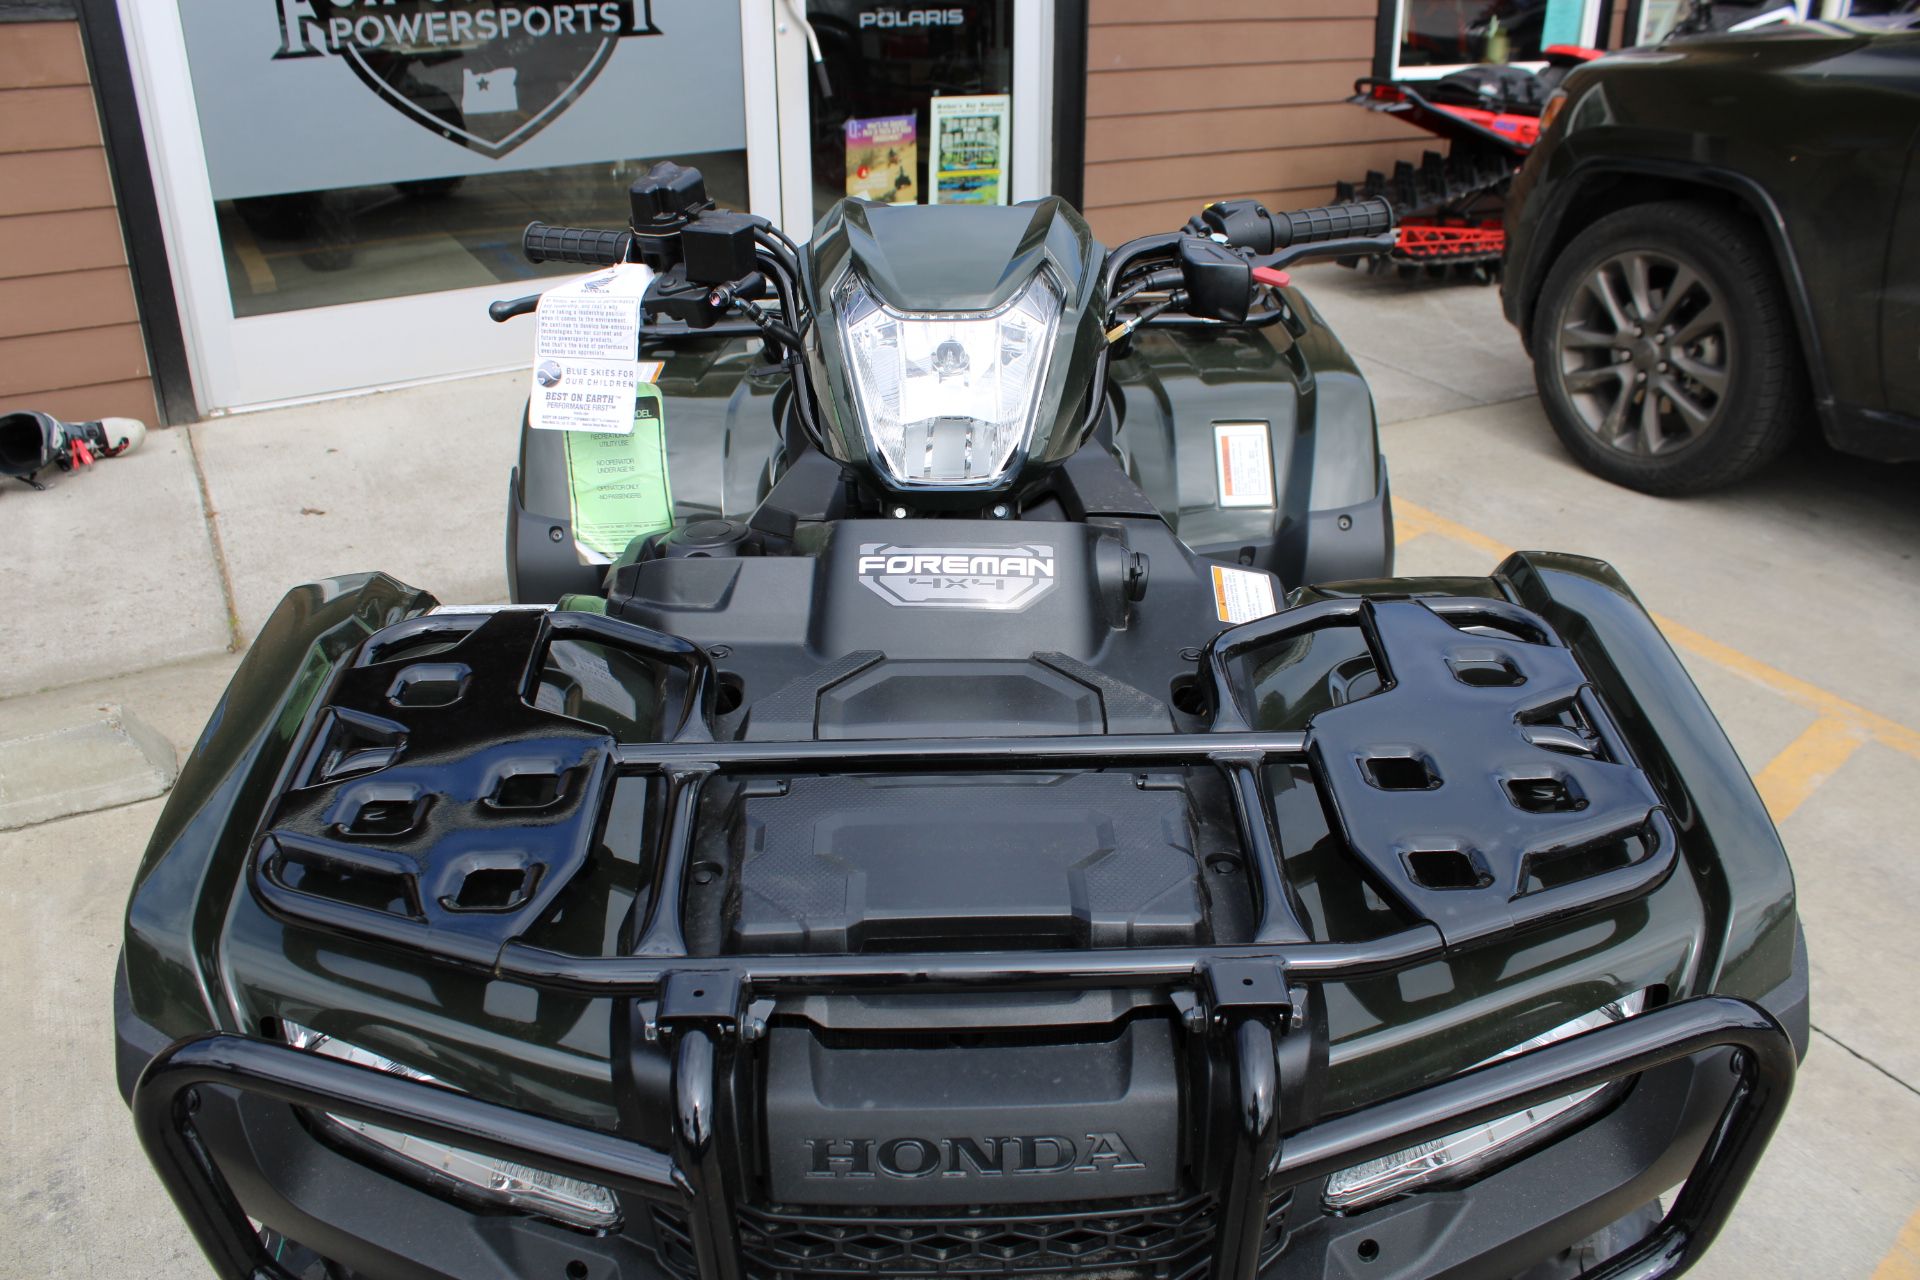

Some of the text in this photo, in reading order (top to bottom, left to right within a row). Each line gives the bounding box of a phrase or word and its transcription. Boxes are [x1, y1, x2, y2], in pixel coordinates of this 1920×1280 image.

[329, 1, 623, 48] POWERSPORTS
[859, 9, 964, 28] POLARIS
[566, 367, 588, 375] BLUE
[618, 370, 634, 378] FOR
[587, 378, 634, 388] CHILDREN
[546, 392, 568, 401] BEST
[571, 393, 583, 402] ON
[546, 402, 590, 410] PERFORMANCE
[858, 556, 1053, 576] FOREMAN
[803, 1131, 1147, 1180] HONDA
